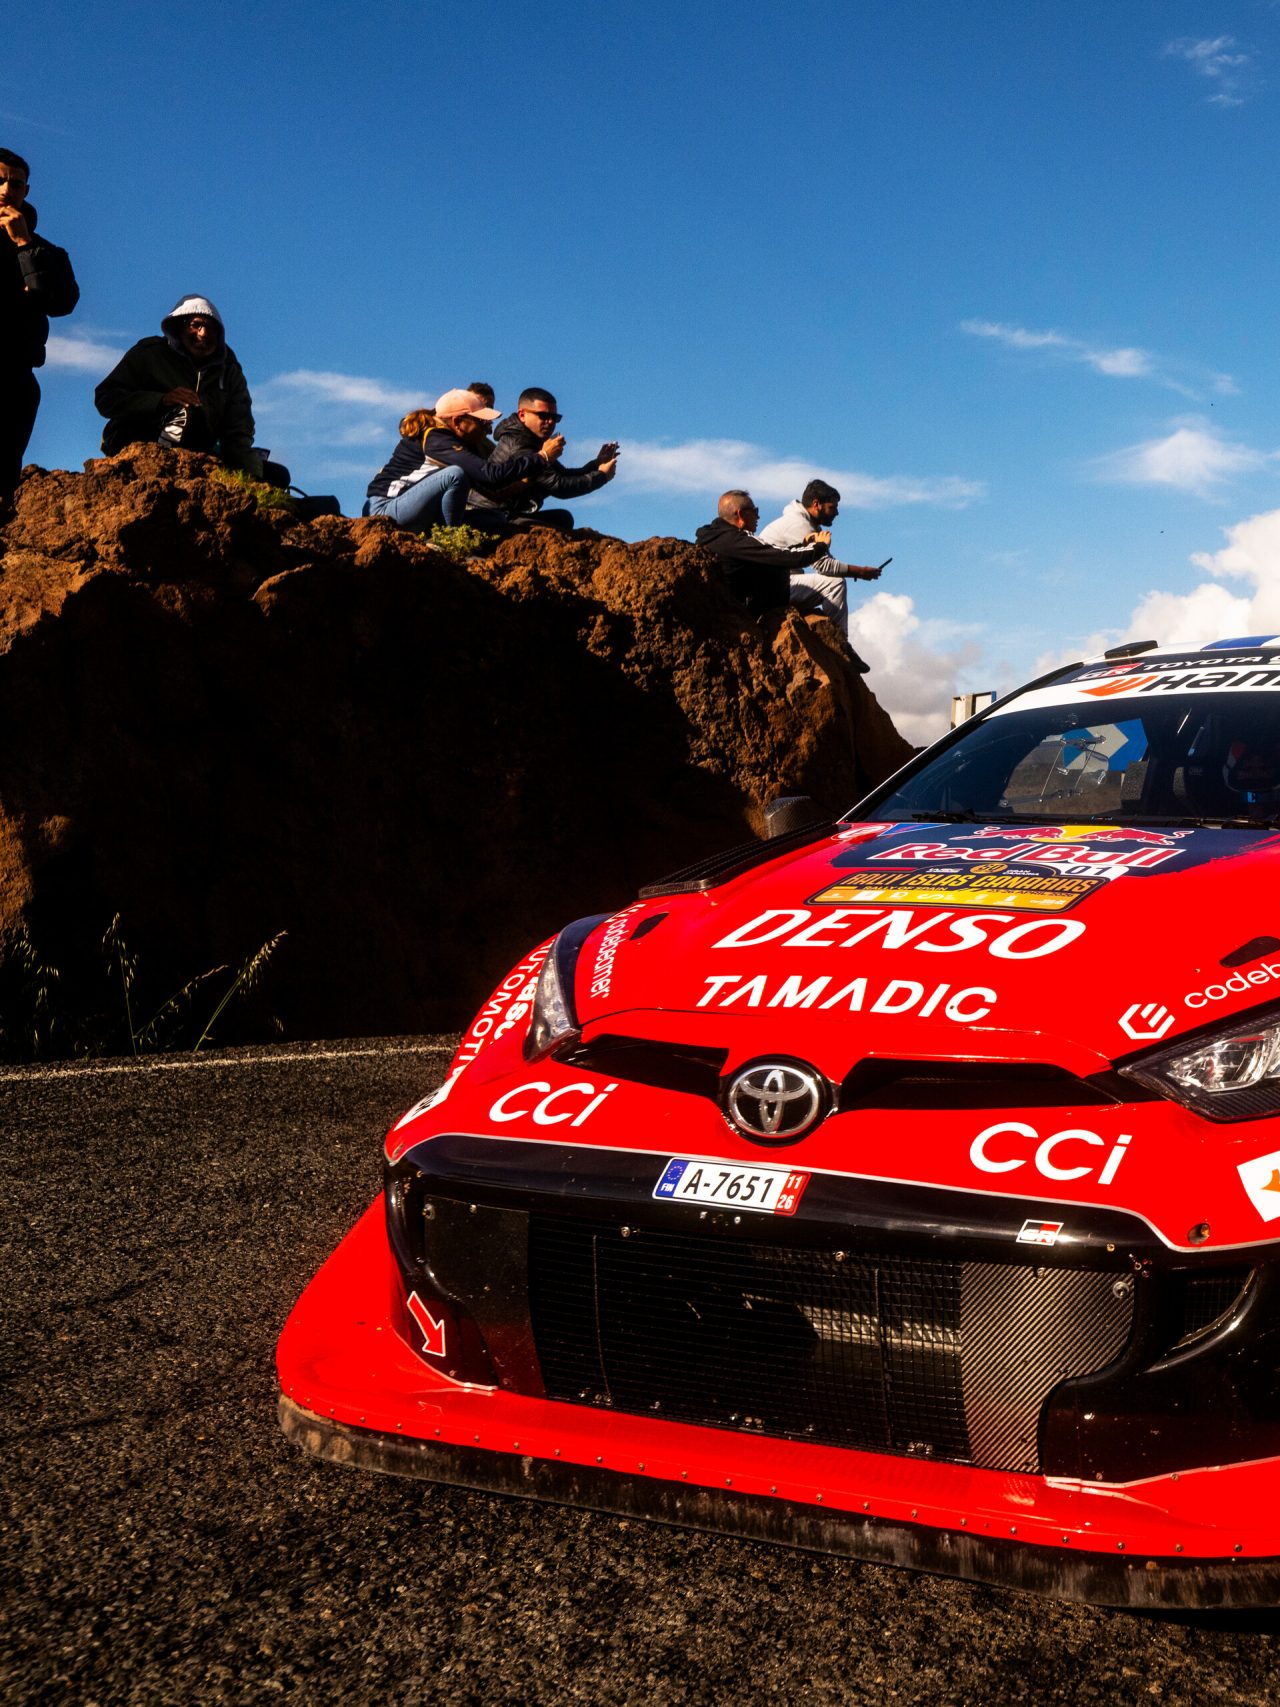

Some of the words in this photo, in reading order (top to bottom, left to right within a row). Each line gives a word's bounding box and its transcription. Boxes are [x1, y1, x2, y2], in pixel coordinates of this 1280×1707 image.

[1142, 655, 1264, 672] TOYOTA
[867, 842, 1043, 862] Red
[1010, 842, 1187, 868] Bull
[1064, 865, 1113, 877] 01
[840, 873, 910, 885] RALLY
[899, 873, 976, 887] ISLAS
[970, 874, 1101, 894] CANARIAS
[711, 909, 1087, 960] DENSO
[590, 918, 629, 998] codebeamer
[696, 974, 998, 1022] TAMADIC
[660, 1183, 675, 1193] FIN
[682, 1168, 774, 1203] A-7651
[786, 1175, 803, 1190] 11
[776, 1194, 795, 1210] 26
